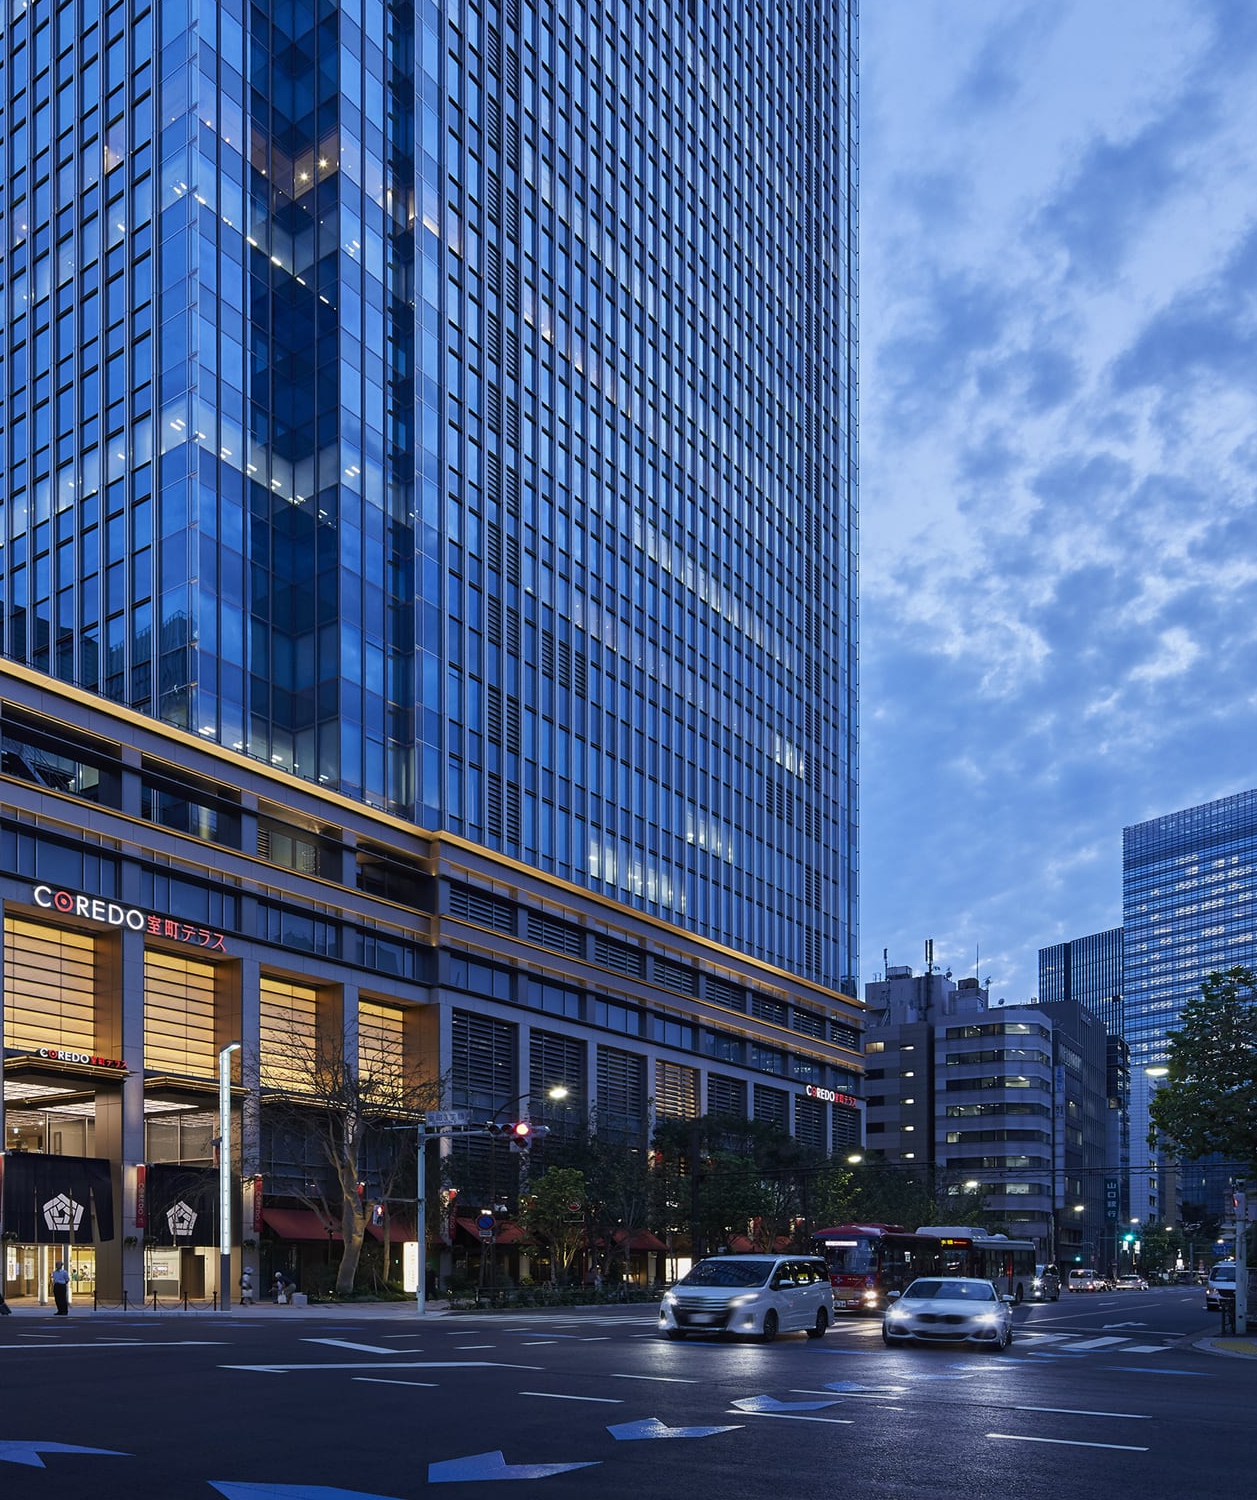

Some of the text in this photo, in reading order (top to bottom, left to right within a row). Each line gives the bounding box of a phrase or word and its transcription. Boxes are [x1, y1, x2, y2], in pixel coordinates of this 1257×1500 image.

[33, 885, 227, 953] COREDO 室町テラス
[39, 1047, 90, 1064] COREDO
[806, 1084, 835, 1102] COREDO
[1106, 1181, 1118, 1218] 山口銀行
